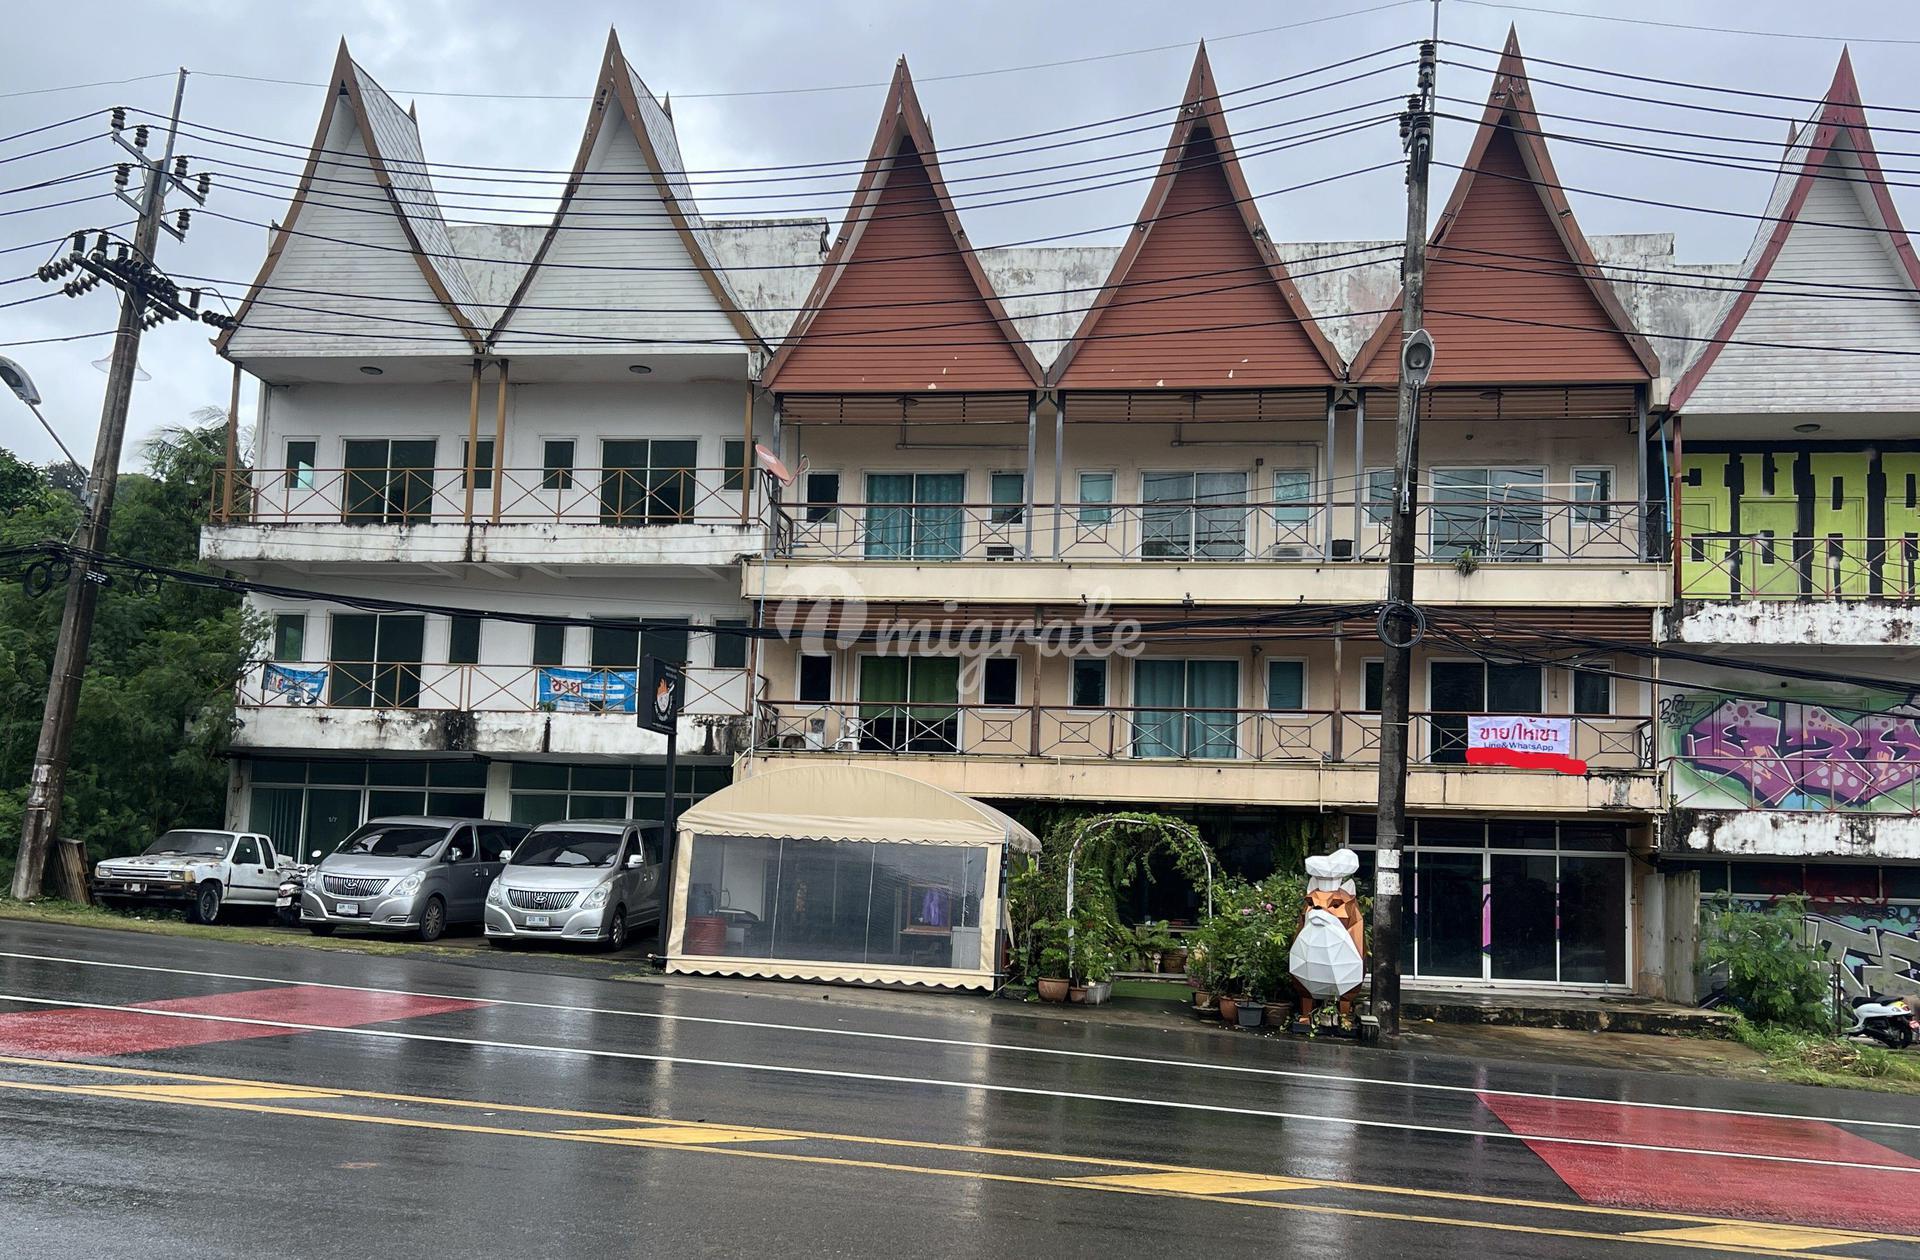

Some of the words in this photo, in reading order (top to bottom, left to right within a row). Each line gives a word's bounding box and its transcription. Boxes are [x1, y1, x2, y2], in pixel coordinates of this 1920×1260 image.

[552, 678, 581, 693] ขาย
[1480, 718, 1558, 742] ขาย/ให้เช่า
[1483, 742, 1554, 752] Line&WhatsApp
